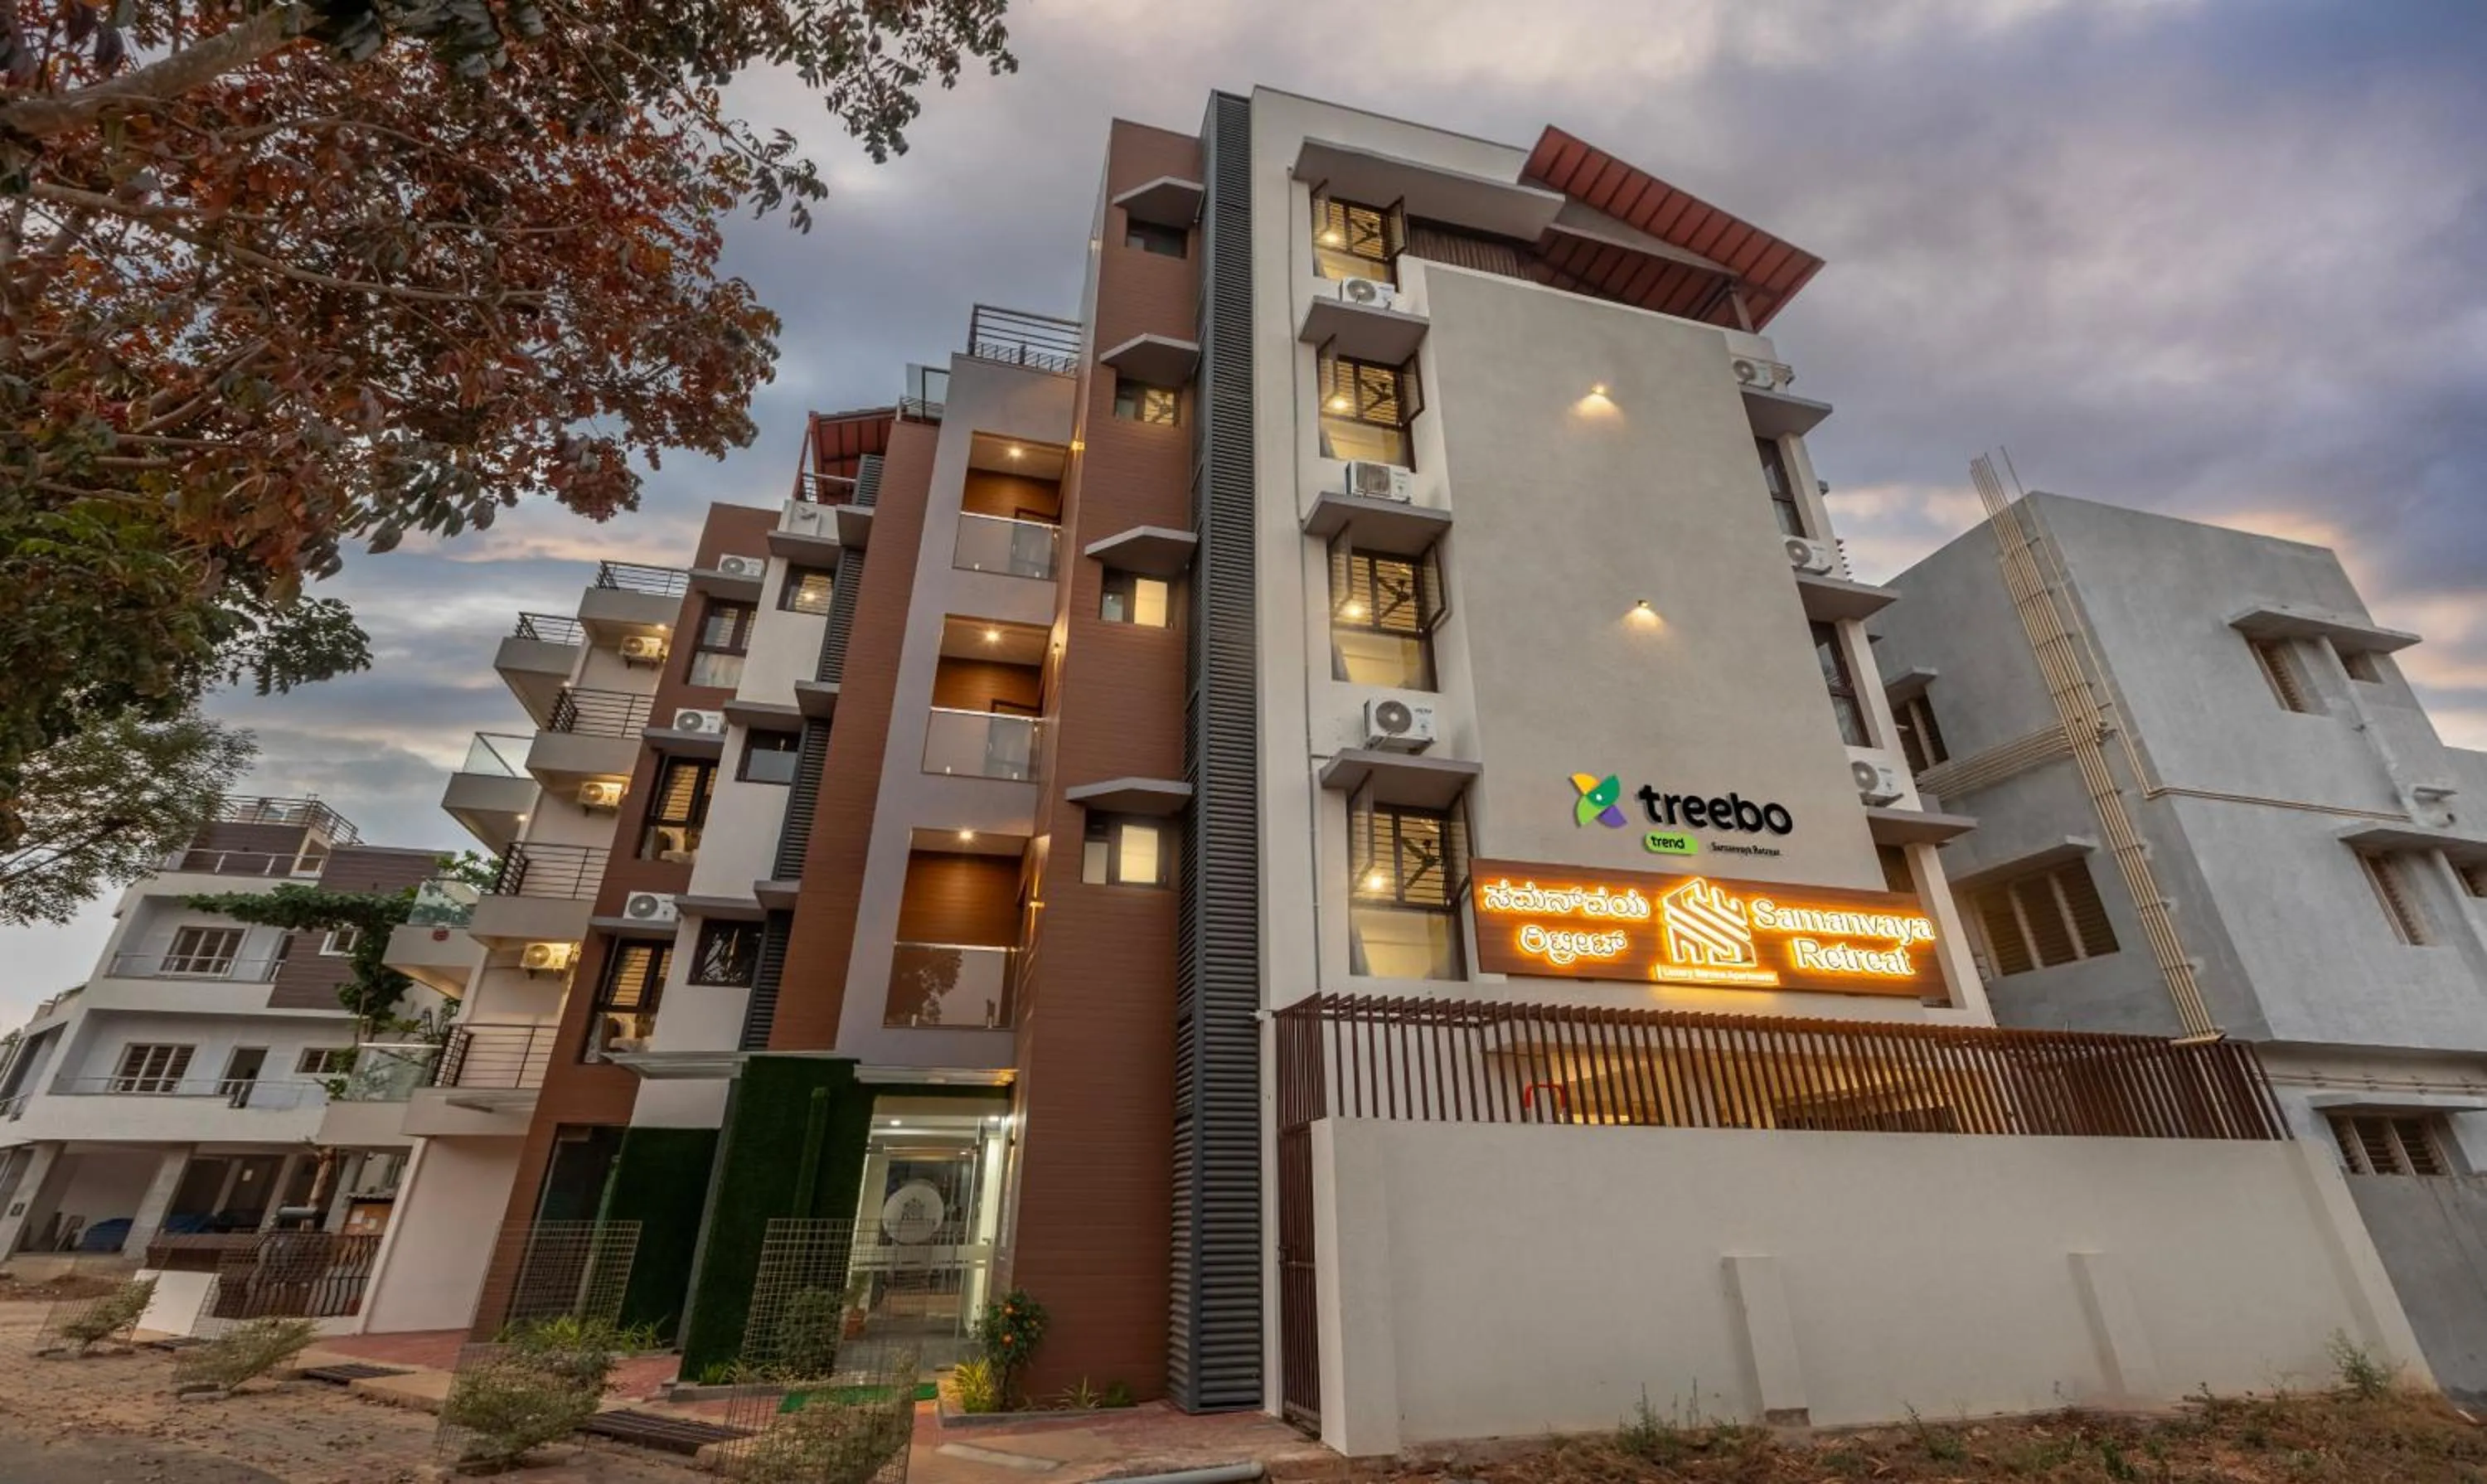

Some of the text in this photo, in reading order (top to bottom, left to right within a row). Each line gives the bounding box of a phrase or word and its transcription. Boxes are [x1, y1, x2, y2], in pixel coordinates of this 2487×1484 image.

[1637, 783, 1792, 835] treebo
[1651, 835, 1685, 850] trend
[1752, 900, 1935, 945] Samanvaya
[1792, 938, 1916, 976] Retreat
